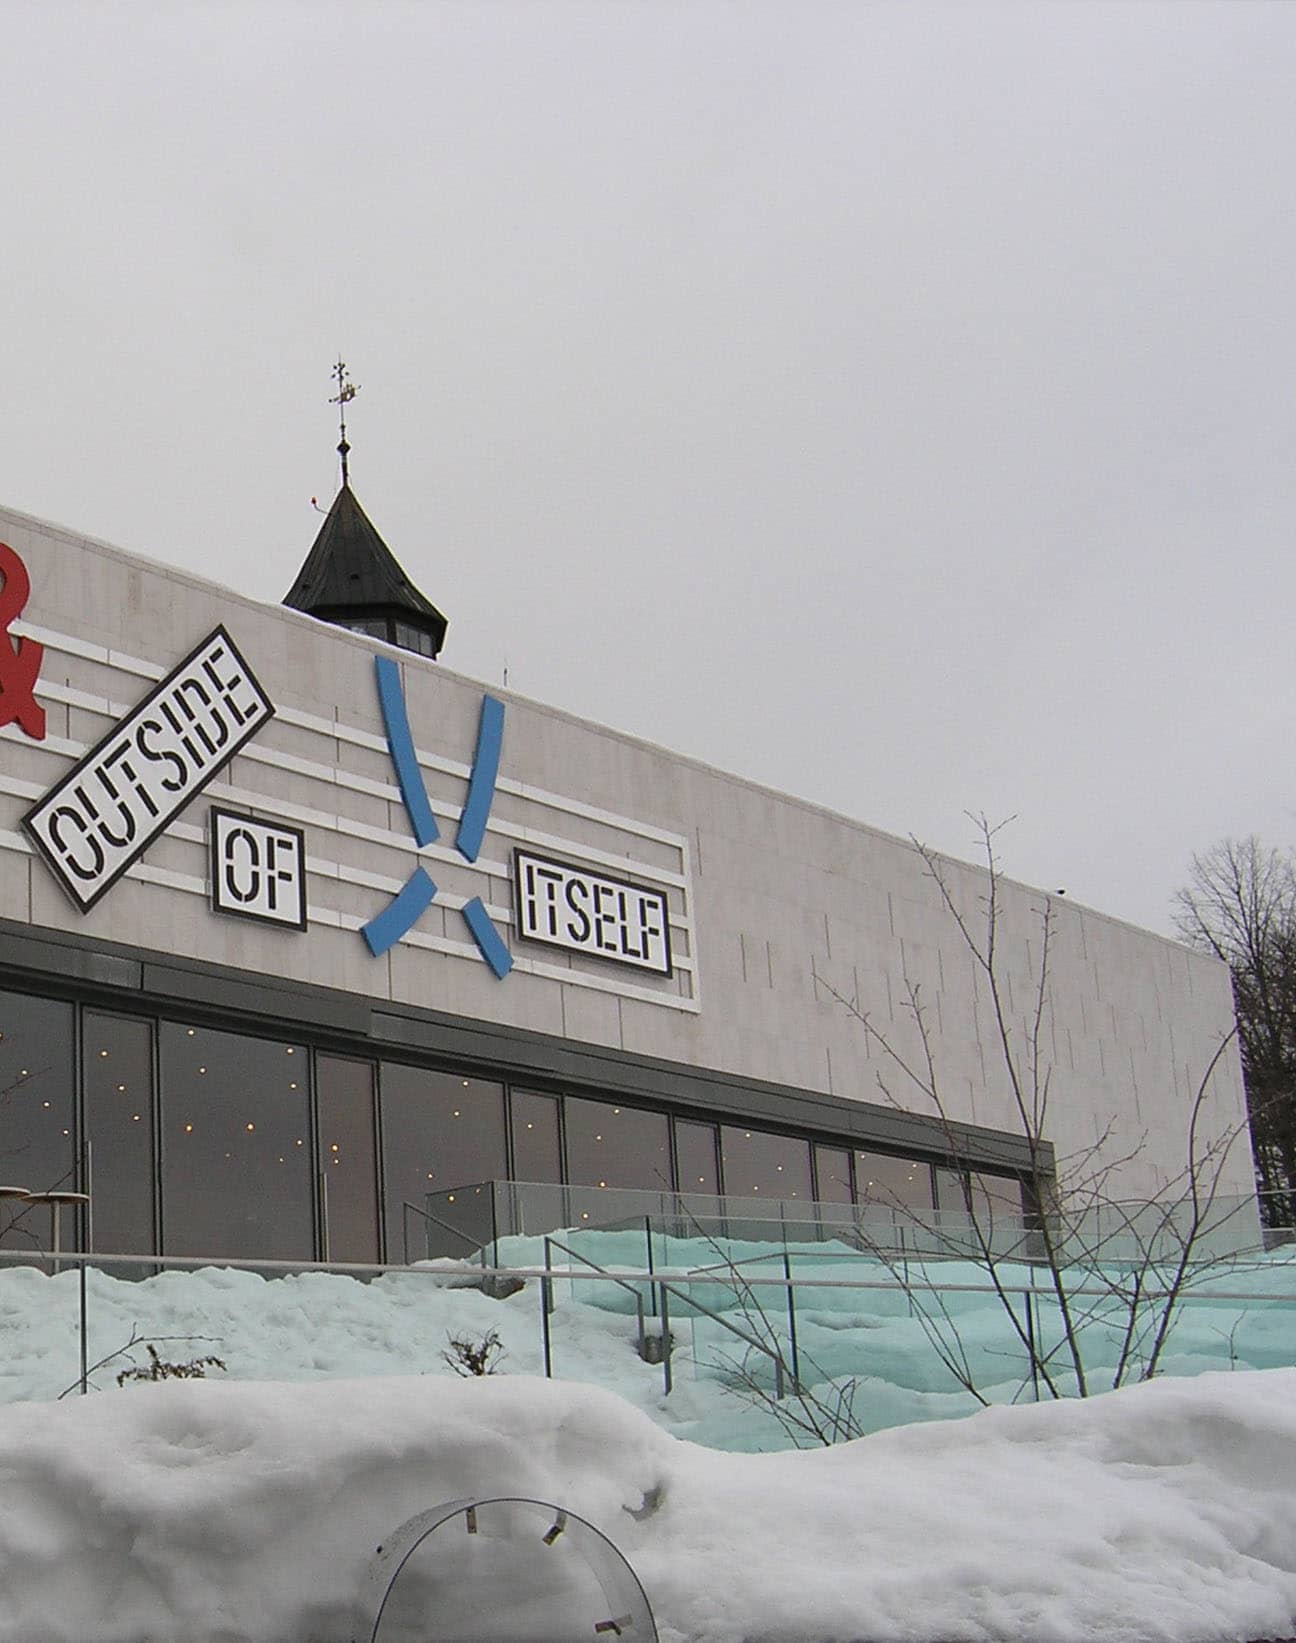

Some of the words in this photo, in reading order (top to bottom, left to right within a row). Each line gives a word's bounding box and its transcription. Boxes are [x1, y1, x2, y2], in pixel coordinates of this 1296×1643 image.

[48, 646, 260, 881] OUTSIDE
[224, 827, 294, 910] OF
[526, 864, 661, 961] ITSELF
